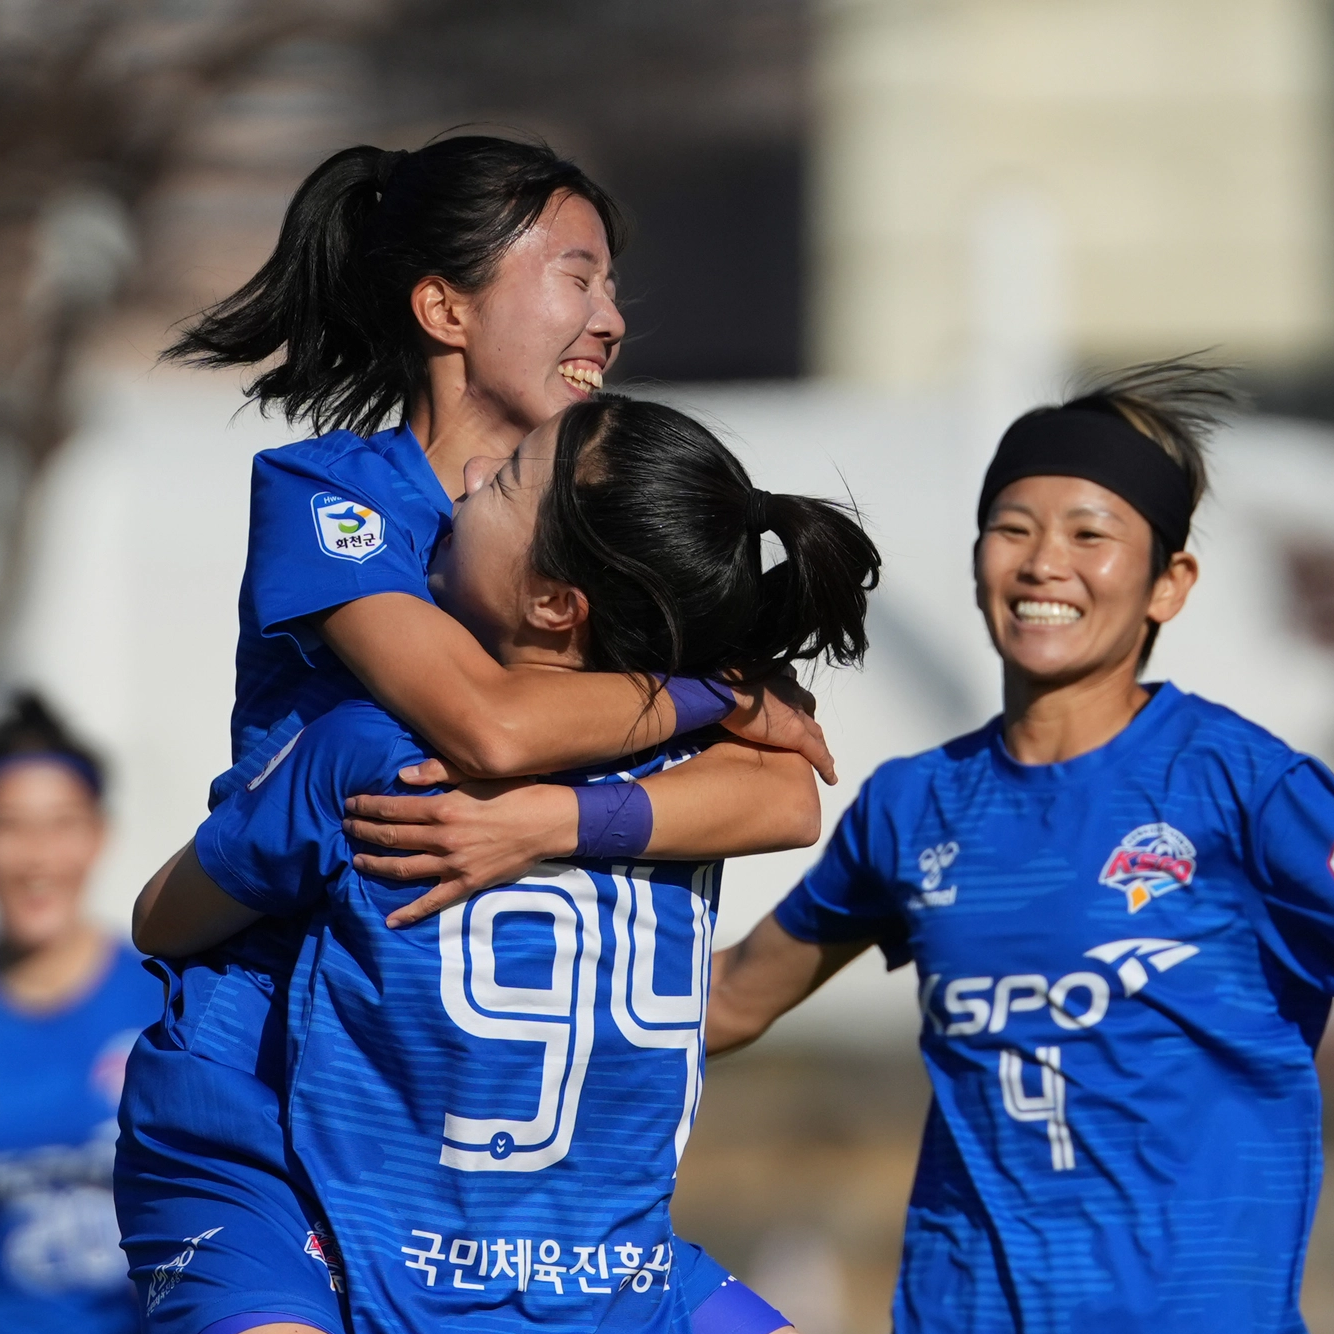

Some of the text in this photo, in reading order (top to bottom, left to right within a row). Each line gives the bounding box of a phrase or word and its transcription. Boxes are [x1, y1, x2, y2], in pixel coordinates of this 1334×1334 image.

[336, 533, 376, 549] 화천군
[439, 862, 712, 1180] 94
[999, 1046, 1075, 1171] 4
[401, 1229, 673, 1295] 국민체육진흥공
